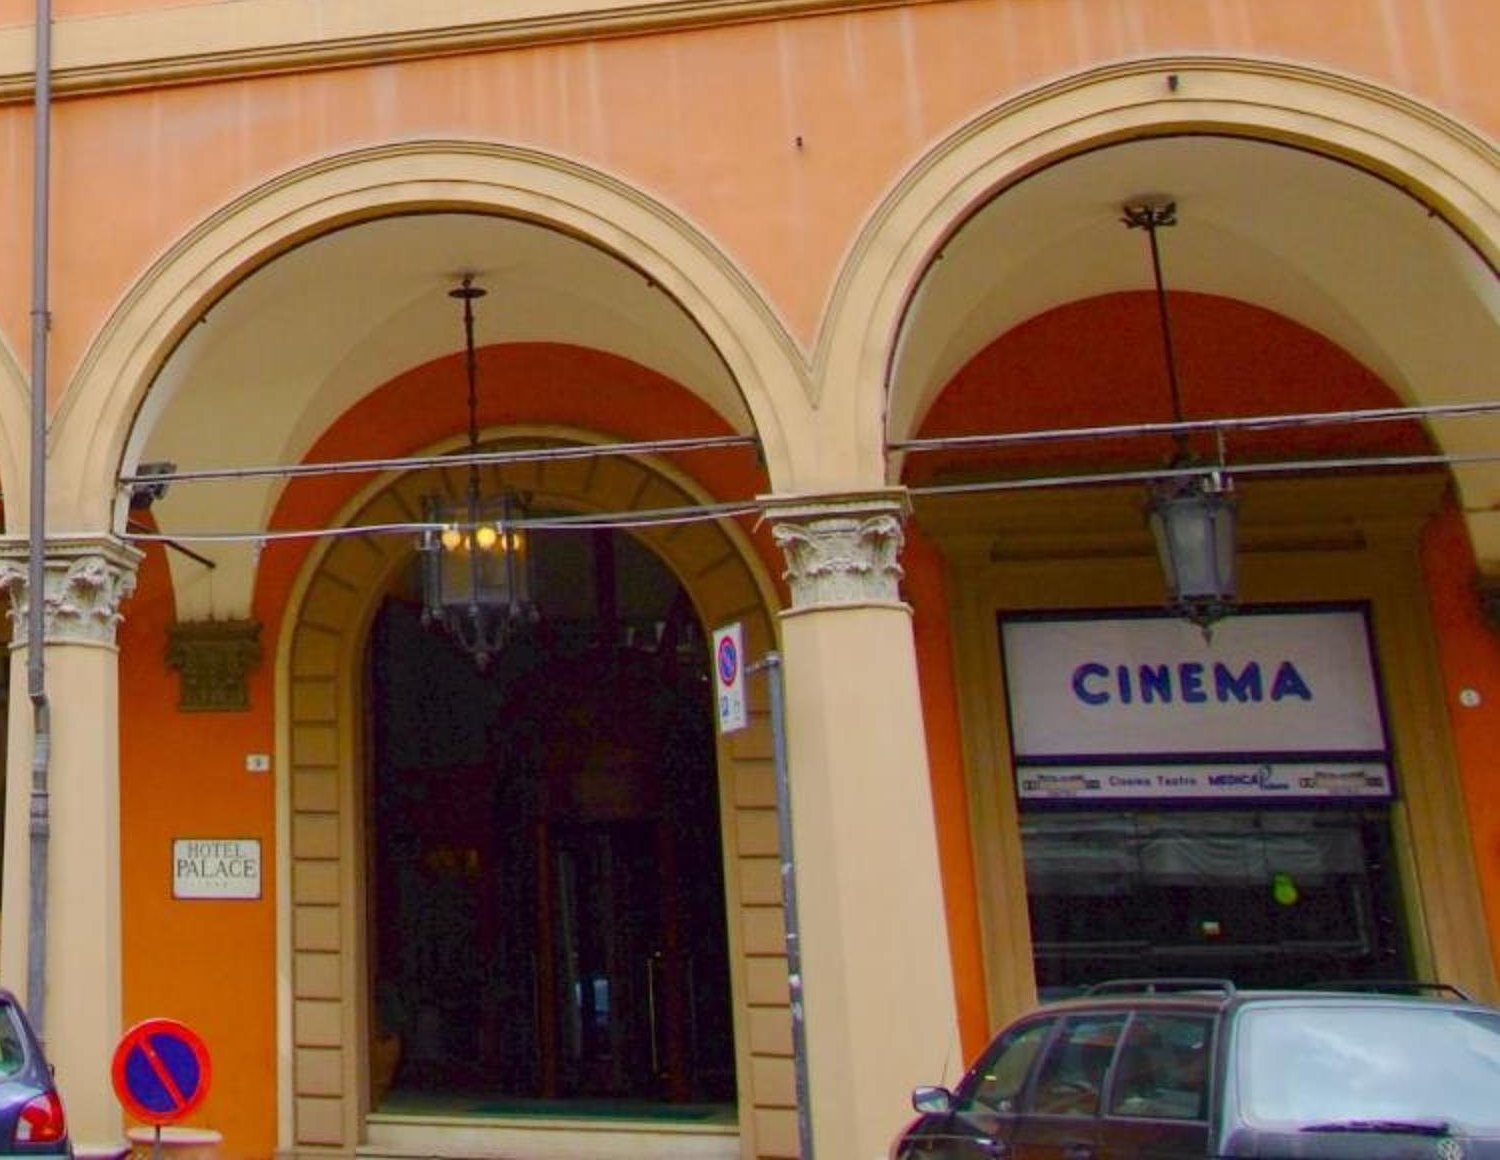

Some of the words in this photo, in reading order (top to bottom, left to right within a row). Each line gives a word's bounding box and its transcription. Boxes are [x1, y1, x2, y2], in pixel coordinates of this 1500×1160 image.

[1071, 660, 1314, 706] CINEMA
[1108, 775, 1151, 787] Cinema
[1157, 774, 1197, 786] Teatro
[1208, 774, 1259, 787] MEDICA
[187, 842, 246, 859] HOTEL
[177, 859, 257, 878] PALACE
